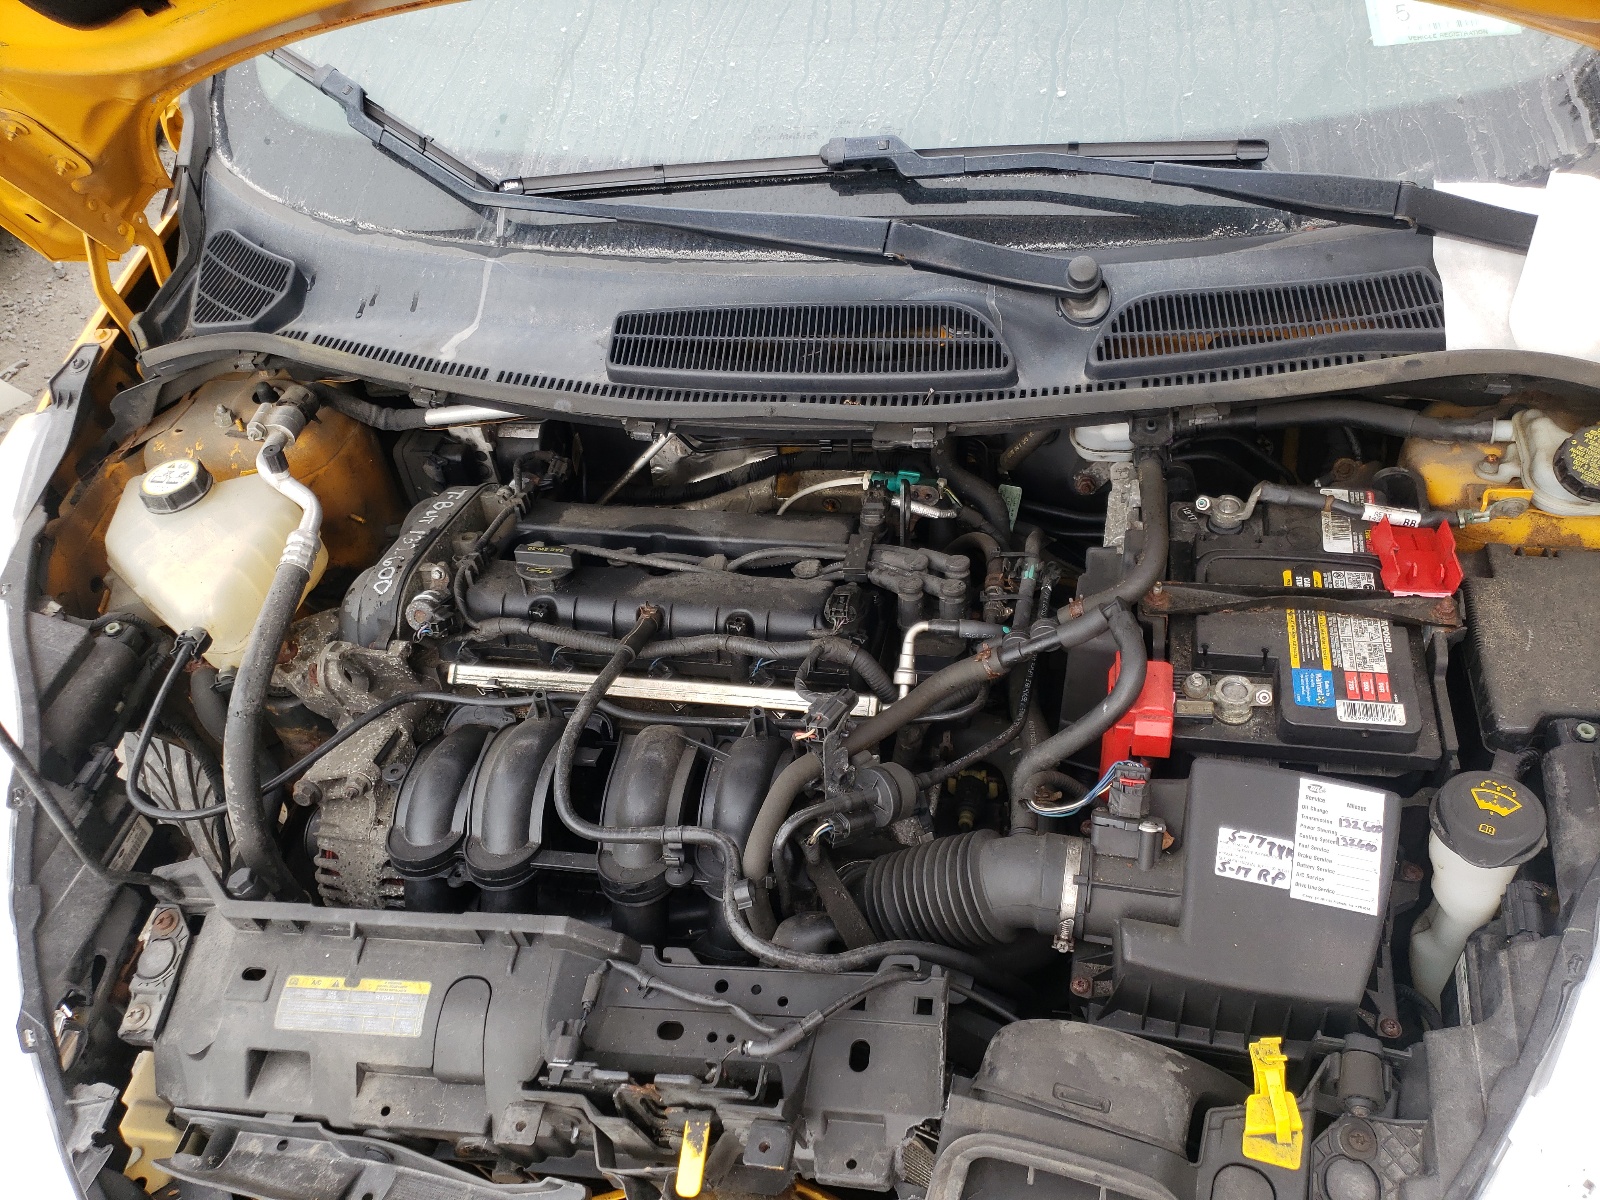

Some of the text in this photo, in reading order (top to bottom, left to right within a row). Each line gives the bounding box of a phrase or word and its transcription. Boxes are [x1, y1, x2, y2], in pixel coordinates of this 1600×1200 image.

[1395, 3, 1411, 22] 5
[1407, 28, 1489, 41] VEHICLE REGISTRATION
[1315, 672, 1324, 696] Walmart
[1305, 794, 1326, 803] Service
[1310, 805, 1328, 814] Change
[1310, 845, 1330, 853] Service
[1313, 855, 1333, 863] Service
[1316, 865, 1336, 874] Service
[1306, 873, 1325, 881] Service
[1318, 886, 1336, 895] Service
